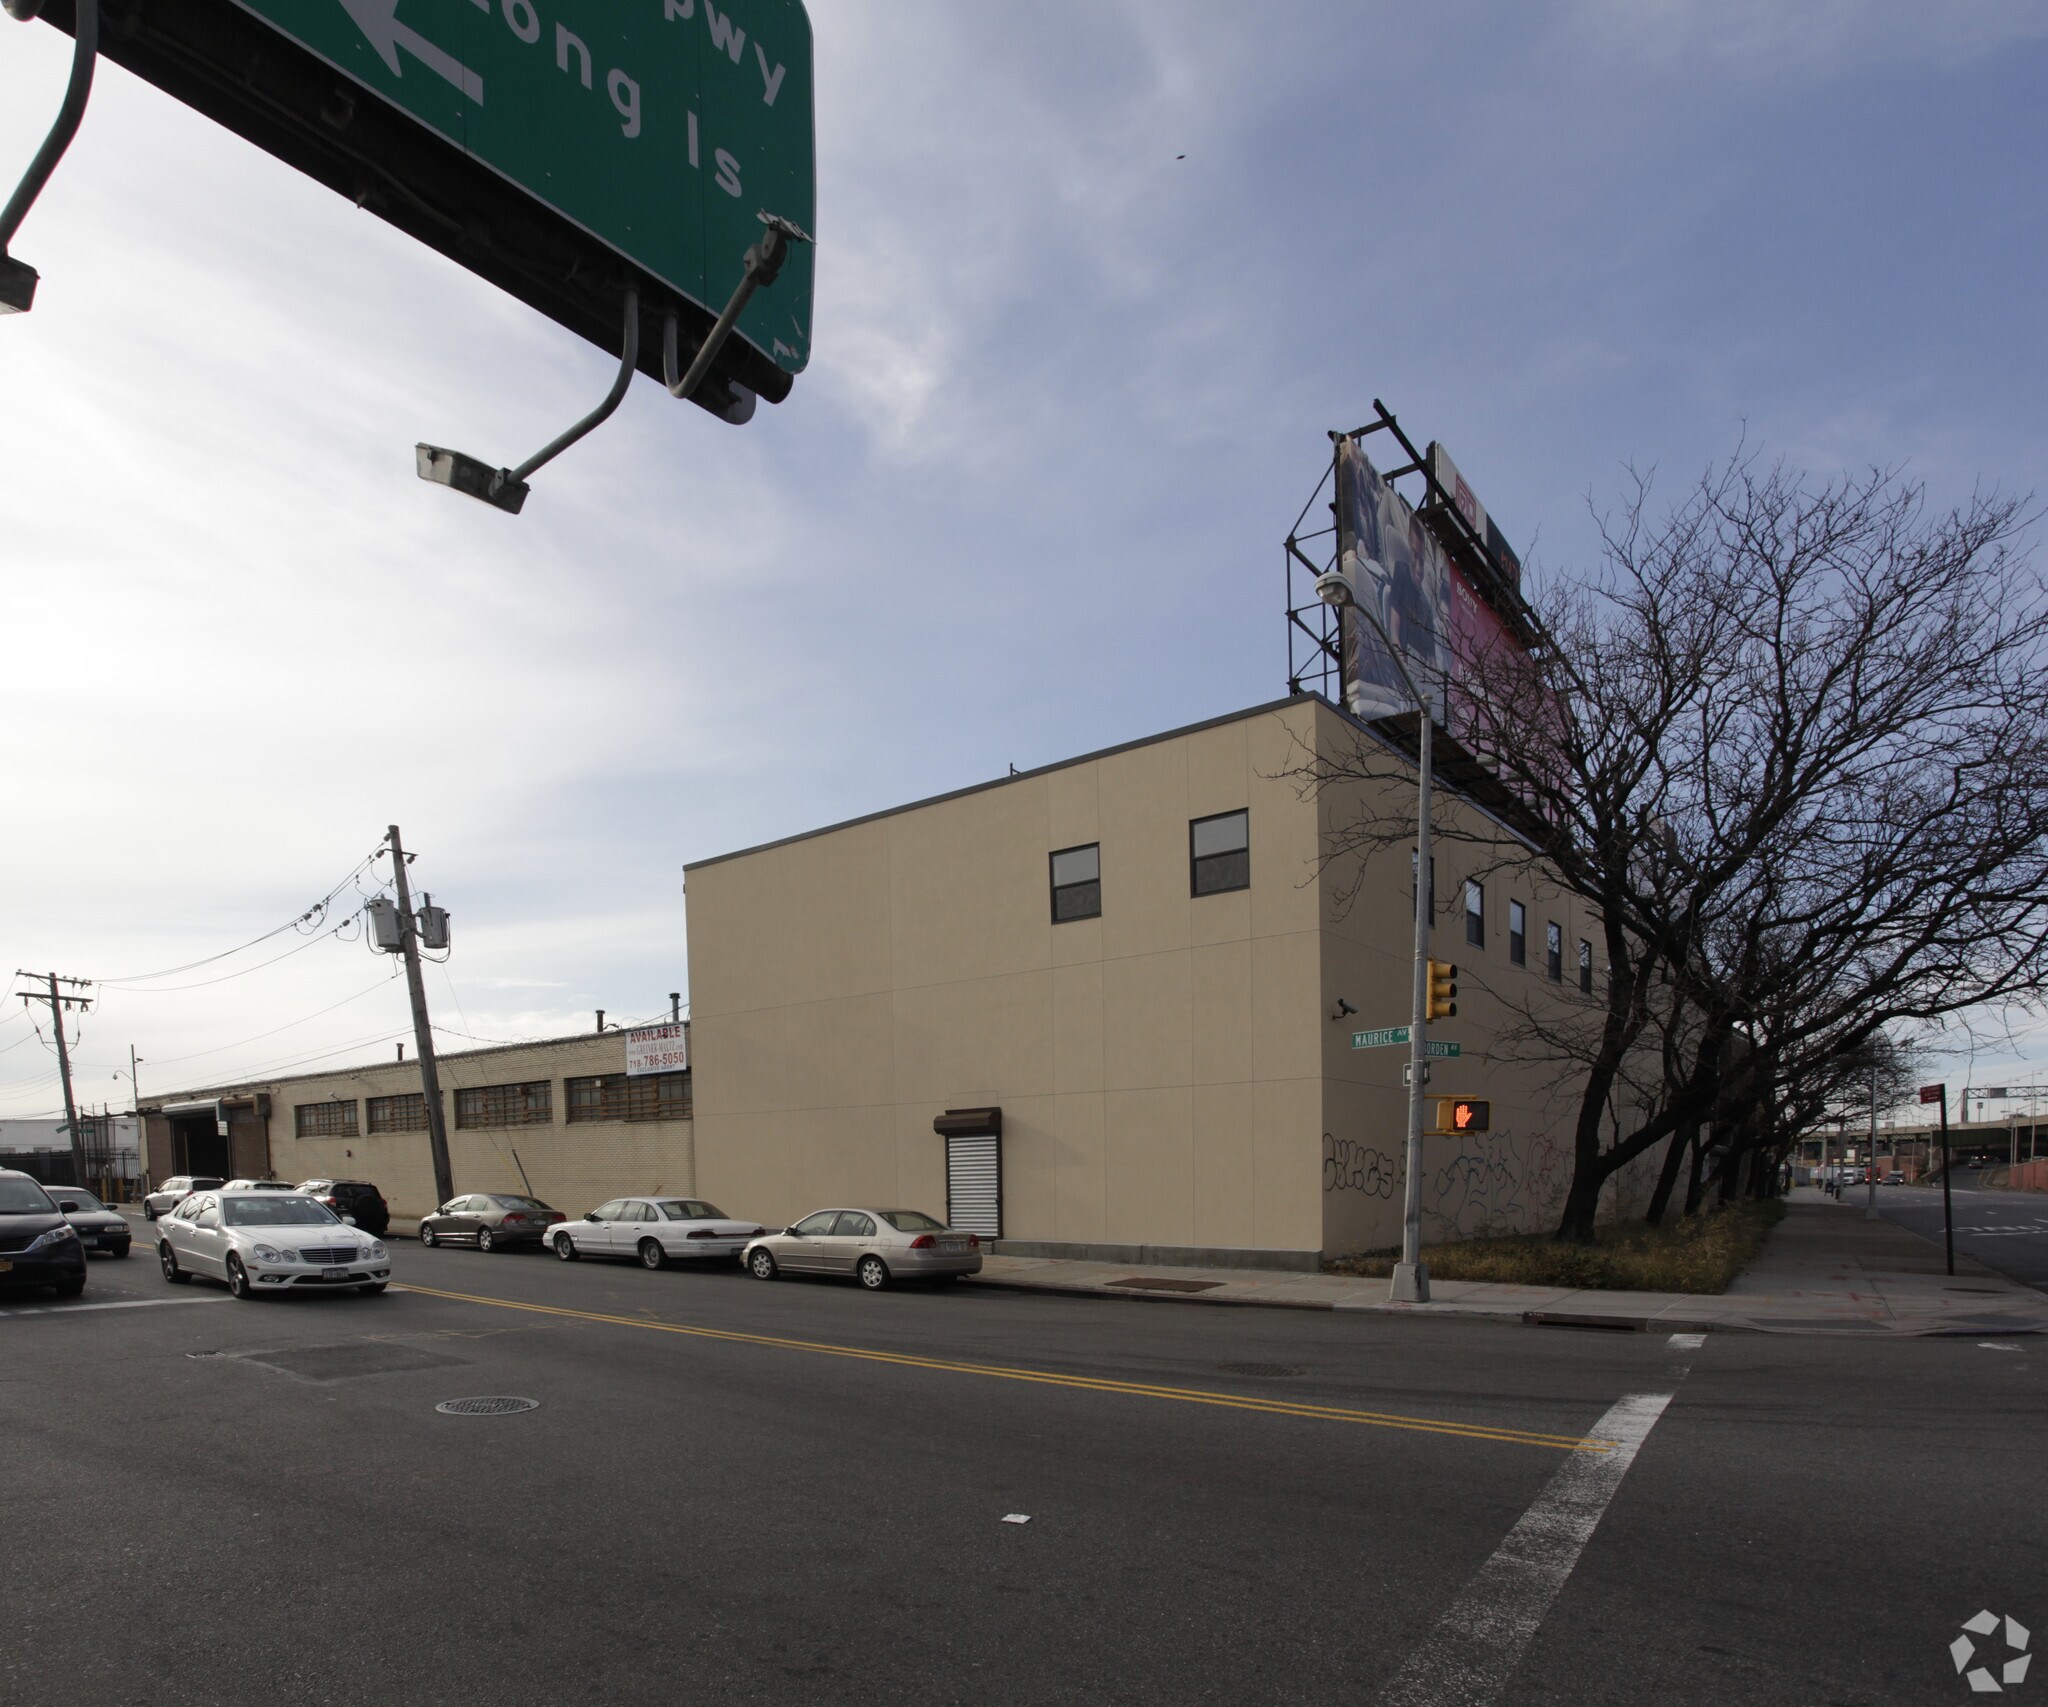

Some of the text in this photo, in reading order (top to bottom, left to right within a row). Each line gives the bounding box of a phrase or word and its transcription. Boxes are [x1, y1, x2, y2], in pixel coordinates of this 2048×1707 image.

[470, 0, 743, 198] ong Is
[1456, 582, 1478, 614] SONY
[630, 1026, 681, 1044] AVAILABLE
[1355, 1029, 1408, 1047] MAURICE AV
[1425, 1043, 1449, 1056] ORDEN
